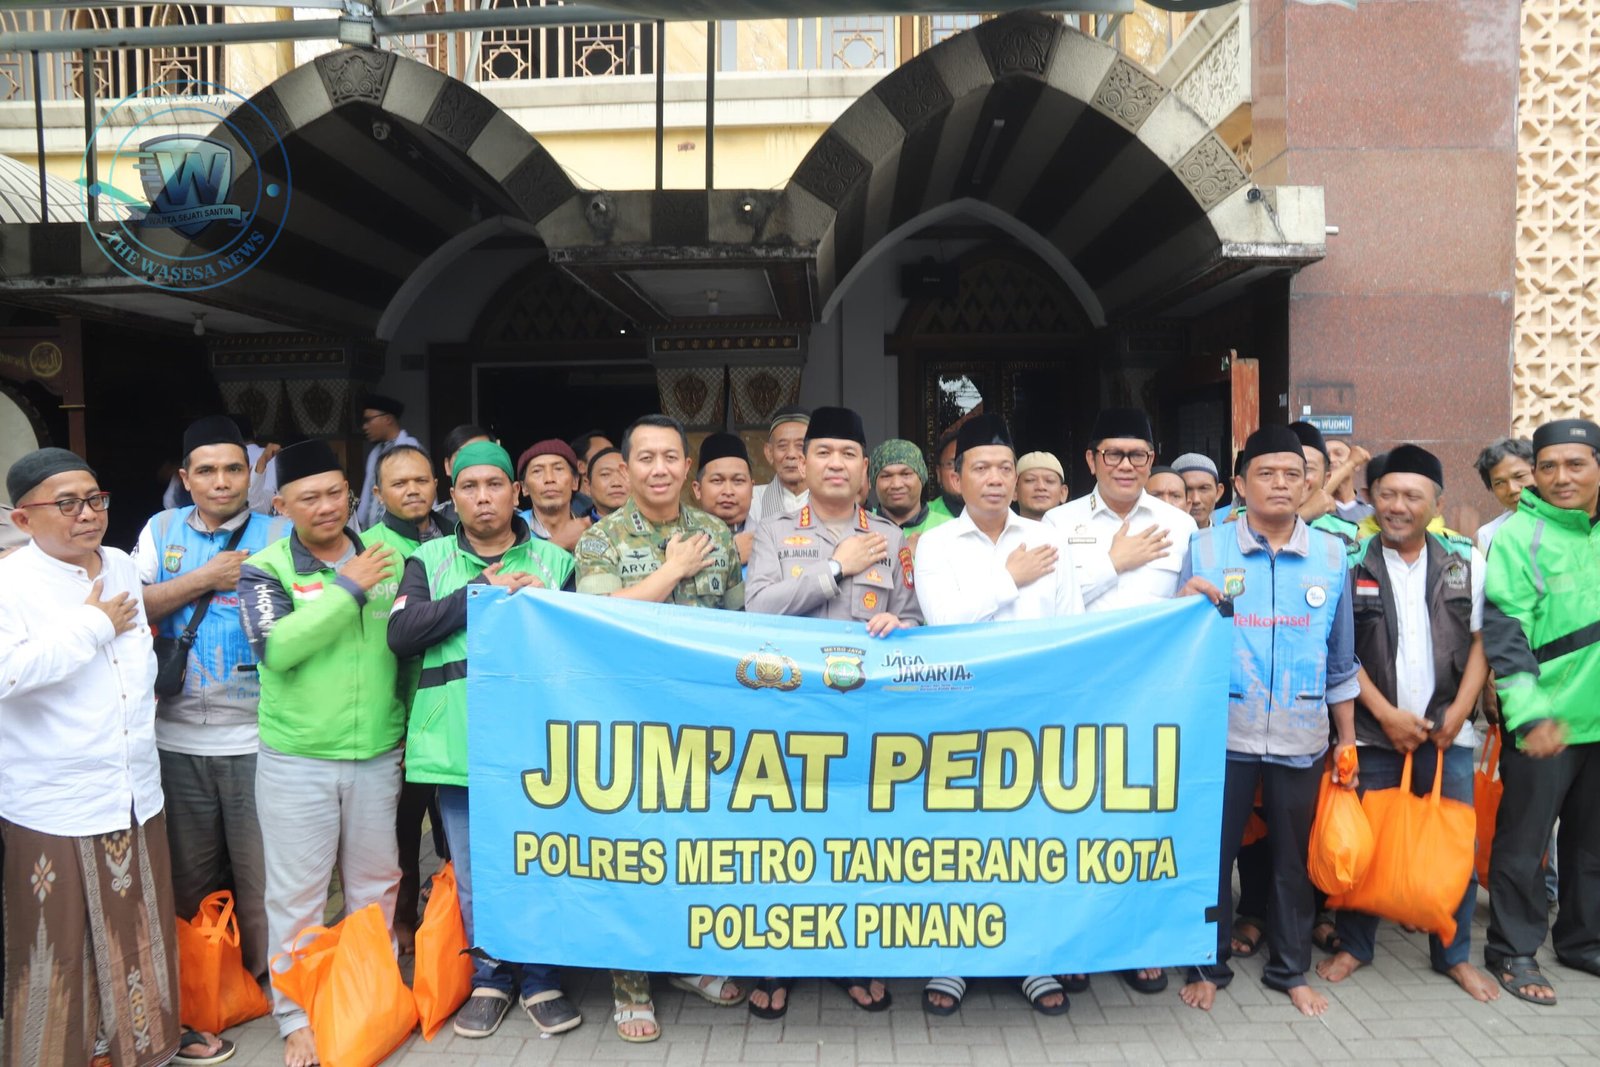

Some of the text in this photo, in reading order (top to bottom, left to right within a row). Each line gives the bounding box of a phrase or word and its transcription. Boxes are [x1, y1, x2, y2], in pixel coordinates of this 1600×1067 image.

[1233, 613, 1311, 632] Telkomsel
[881, 653, 924, 668] JAGA
[521, 720, 1180, 814] JUM'AT PEDULI
[514, 831, 1178, 885] POLRES METRO TANGERANG KOTA
[688, 902, 1006, 950] POLSEK PINANG
